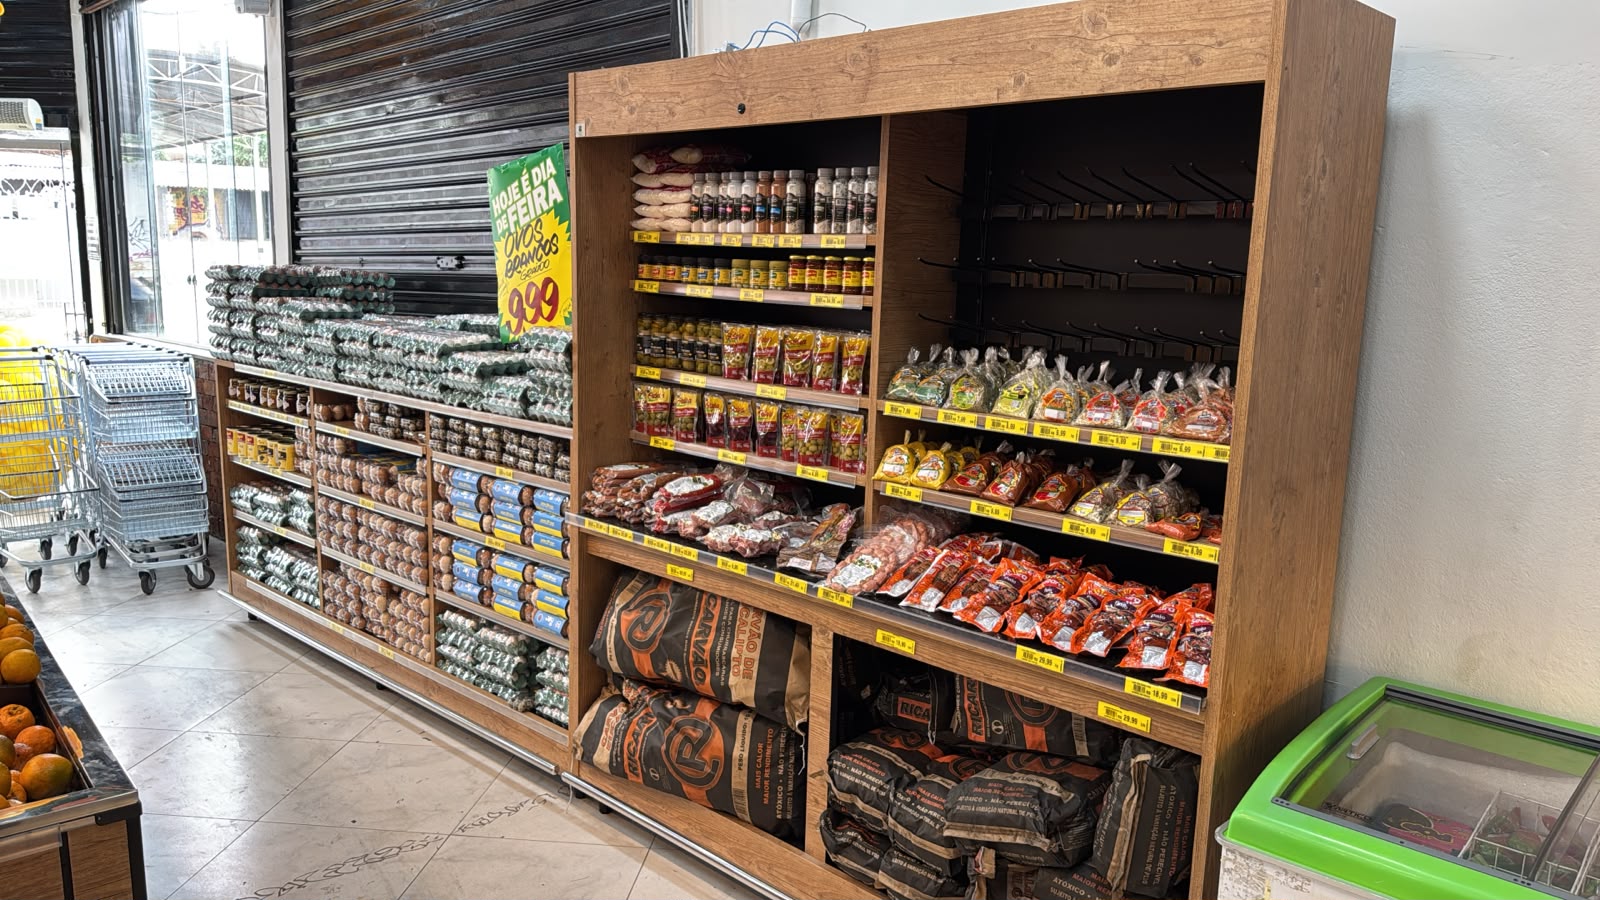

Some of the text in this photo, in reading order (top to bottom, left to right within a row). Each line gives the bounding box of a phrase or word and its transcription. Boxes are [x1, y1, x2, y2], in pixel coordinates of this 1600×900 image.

[492, 157, 557, 218] HOJE É DIA
[496, 177, 563, 234] DE FEIRA
[505, 218, 543, 258] OVOS
[505, 233, 558, 278] BRANCOS
[693, 593, 718, 685] CARVÃO
[731, 606, 751, 678] CALIPTO
[742, 608, 763, 680] RVÃO DE
[900, 701, 931, 720] RICA
[967, 680, 983, 736] RICAR
[627, 712, 656, 777] RICAR
[764, 729, 774, 778] RENDIMENTO
[775, 786, 783, 819] ATÓXICO
[1072, 873, 1096, 889] MAIOR
